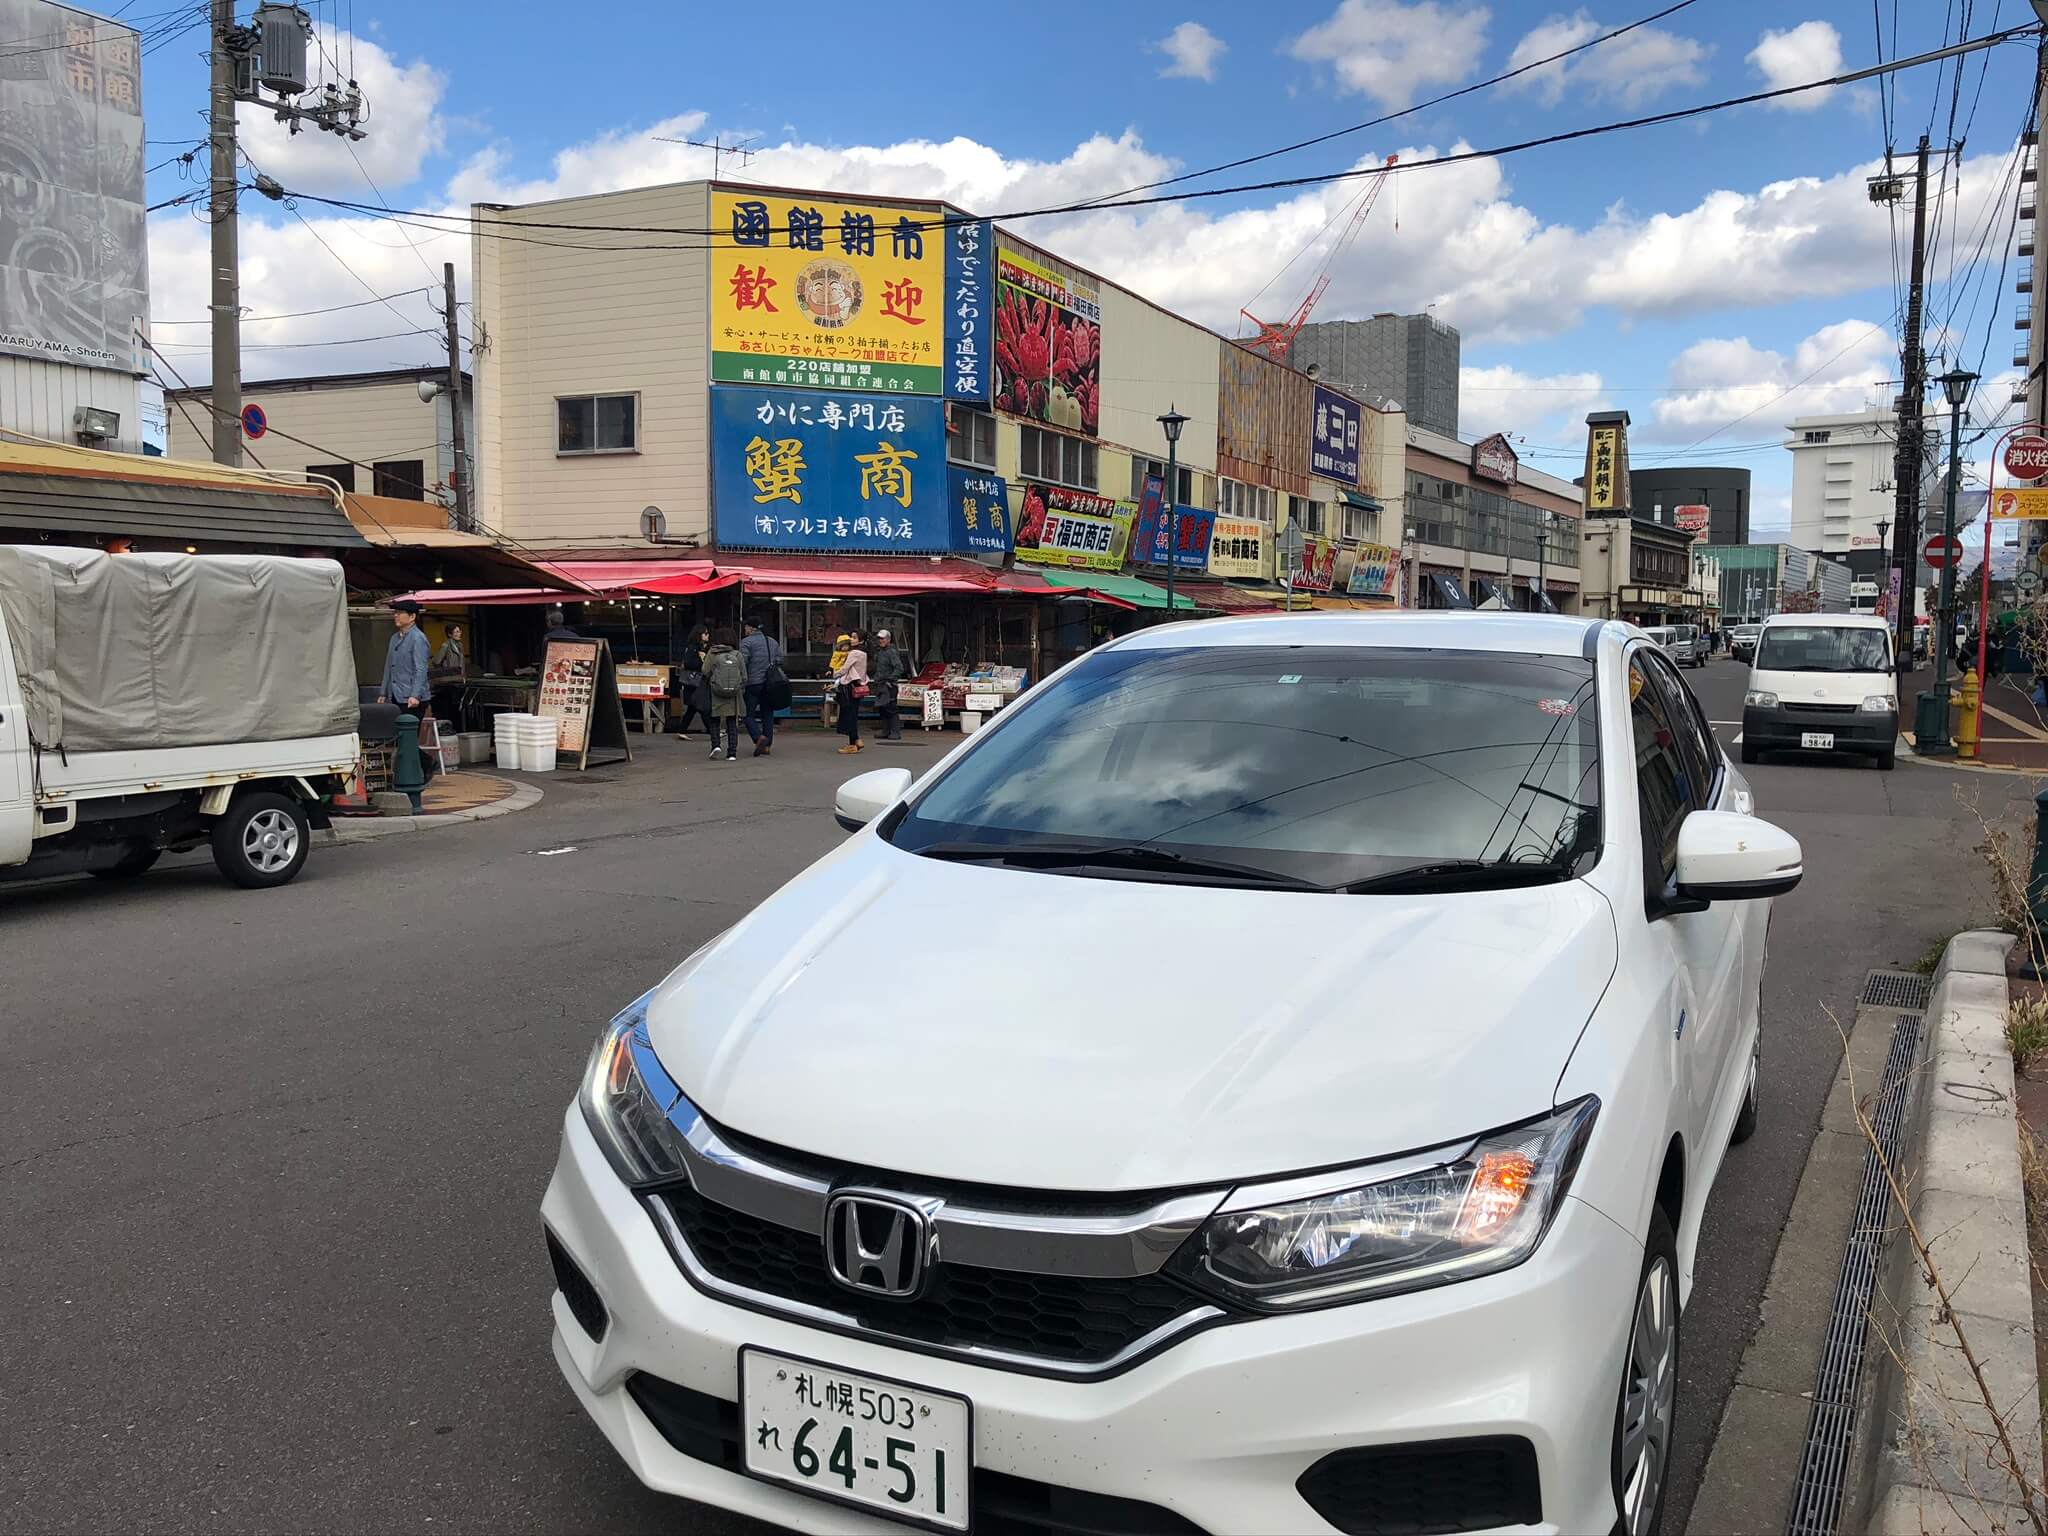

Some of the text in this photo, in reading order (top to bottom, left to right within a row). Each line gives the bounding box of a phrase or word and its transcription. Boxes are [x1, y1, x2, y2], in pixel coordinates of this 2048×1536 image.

[732, 201, 925, 260] 函館朝市
[743, 368, 915, 390] 函館朝市協同組合連合会
[787, 359, 872, 375] 220店舗加盟
[756, 400, 906, 433] かに専門店
[744, 435, 919, 508] 蟹商
[2008, 449, 2048, 467] 消火栓
[1057, 518, 1112, 552] 福田商店
[795, 1373, 915, 1430] 札幌503
[758, 1417, 946, 1514] れ 64-51
